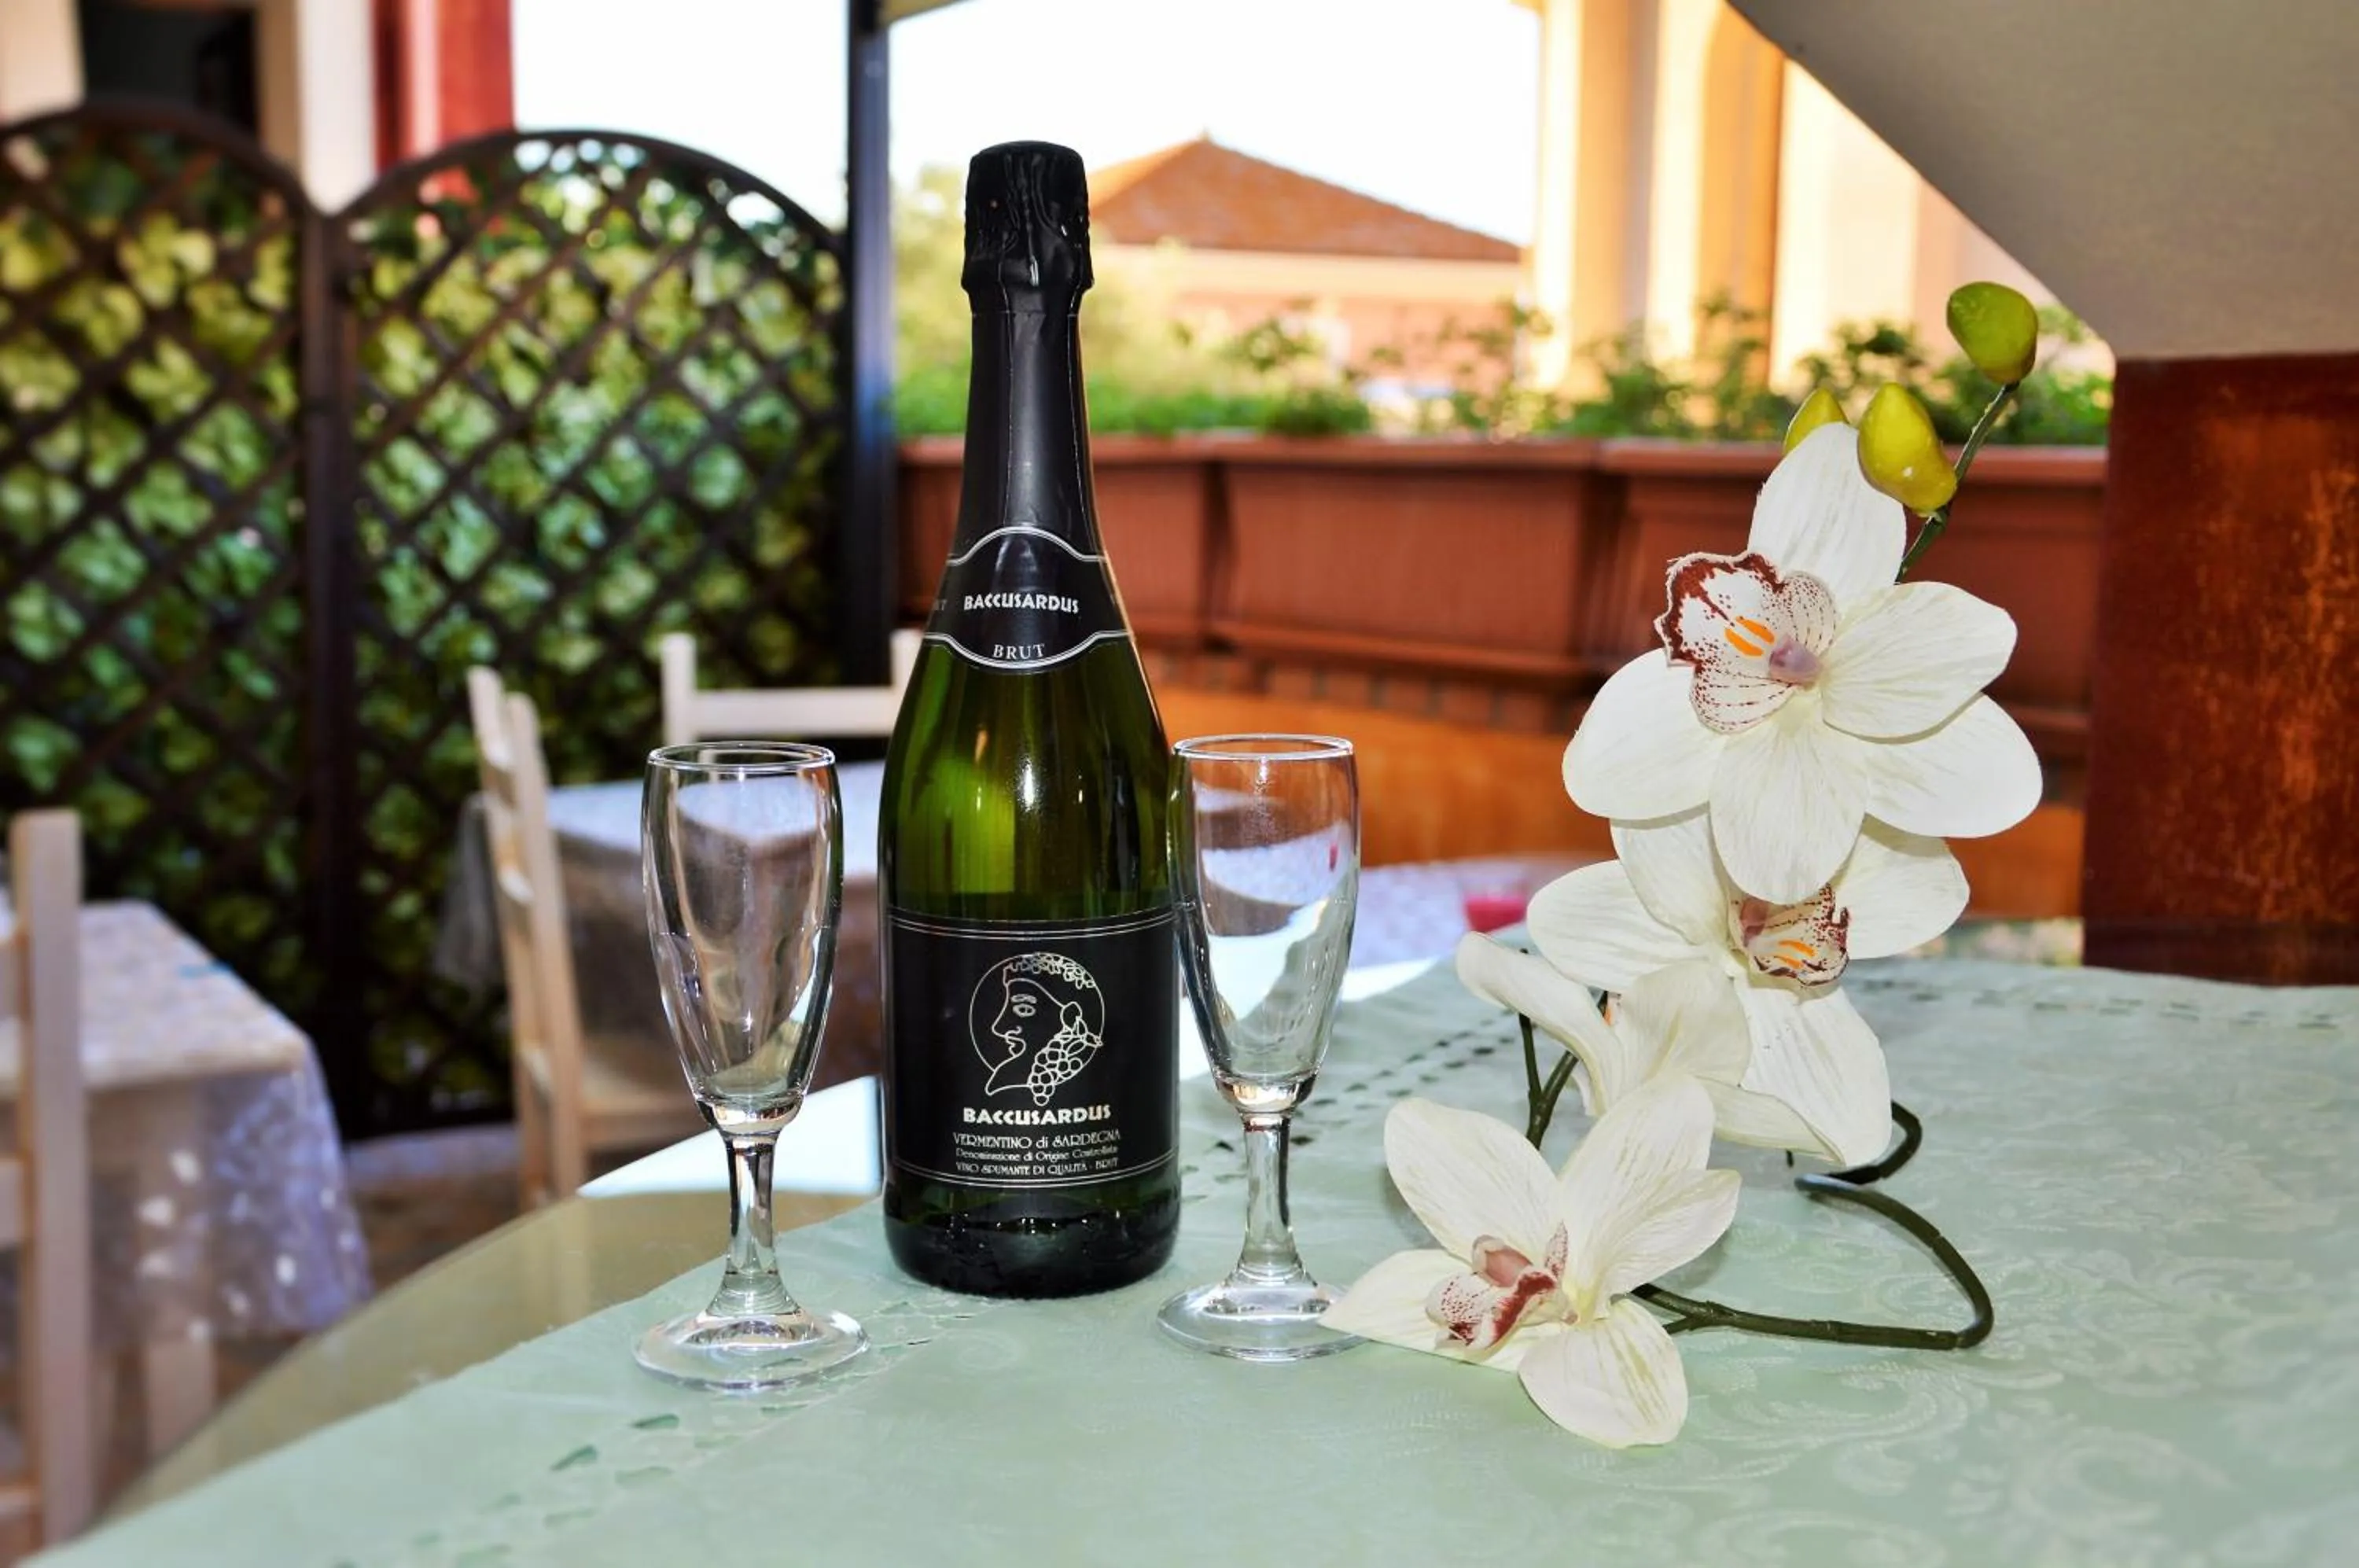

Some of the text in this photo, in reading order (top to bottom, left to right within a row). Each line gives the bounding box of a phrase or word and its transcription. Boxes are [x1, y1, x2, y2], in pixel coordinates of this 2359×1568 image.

[963, 592, 1079, 613] BACCUSARDUS
[993, 643, 1045, 659] BRUT
[963, 1104, 1111, 1125] BACCUSARDUS
[952, 1128, 1121, 1149] VERMENTINO di SARDEGNA
[1024, 1151, 1033, 1161] di
[1036, 1150, 1069, 1162] Origine
[955, 1161, 979, 1173] VINO
[981, 1164, 1031, 1176] SPUMANTE
[1032, 1165, 1045, 1175] DI
